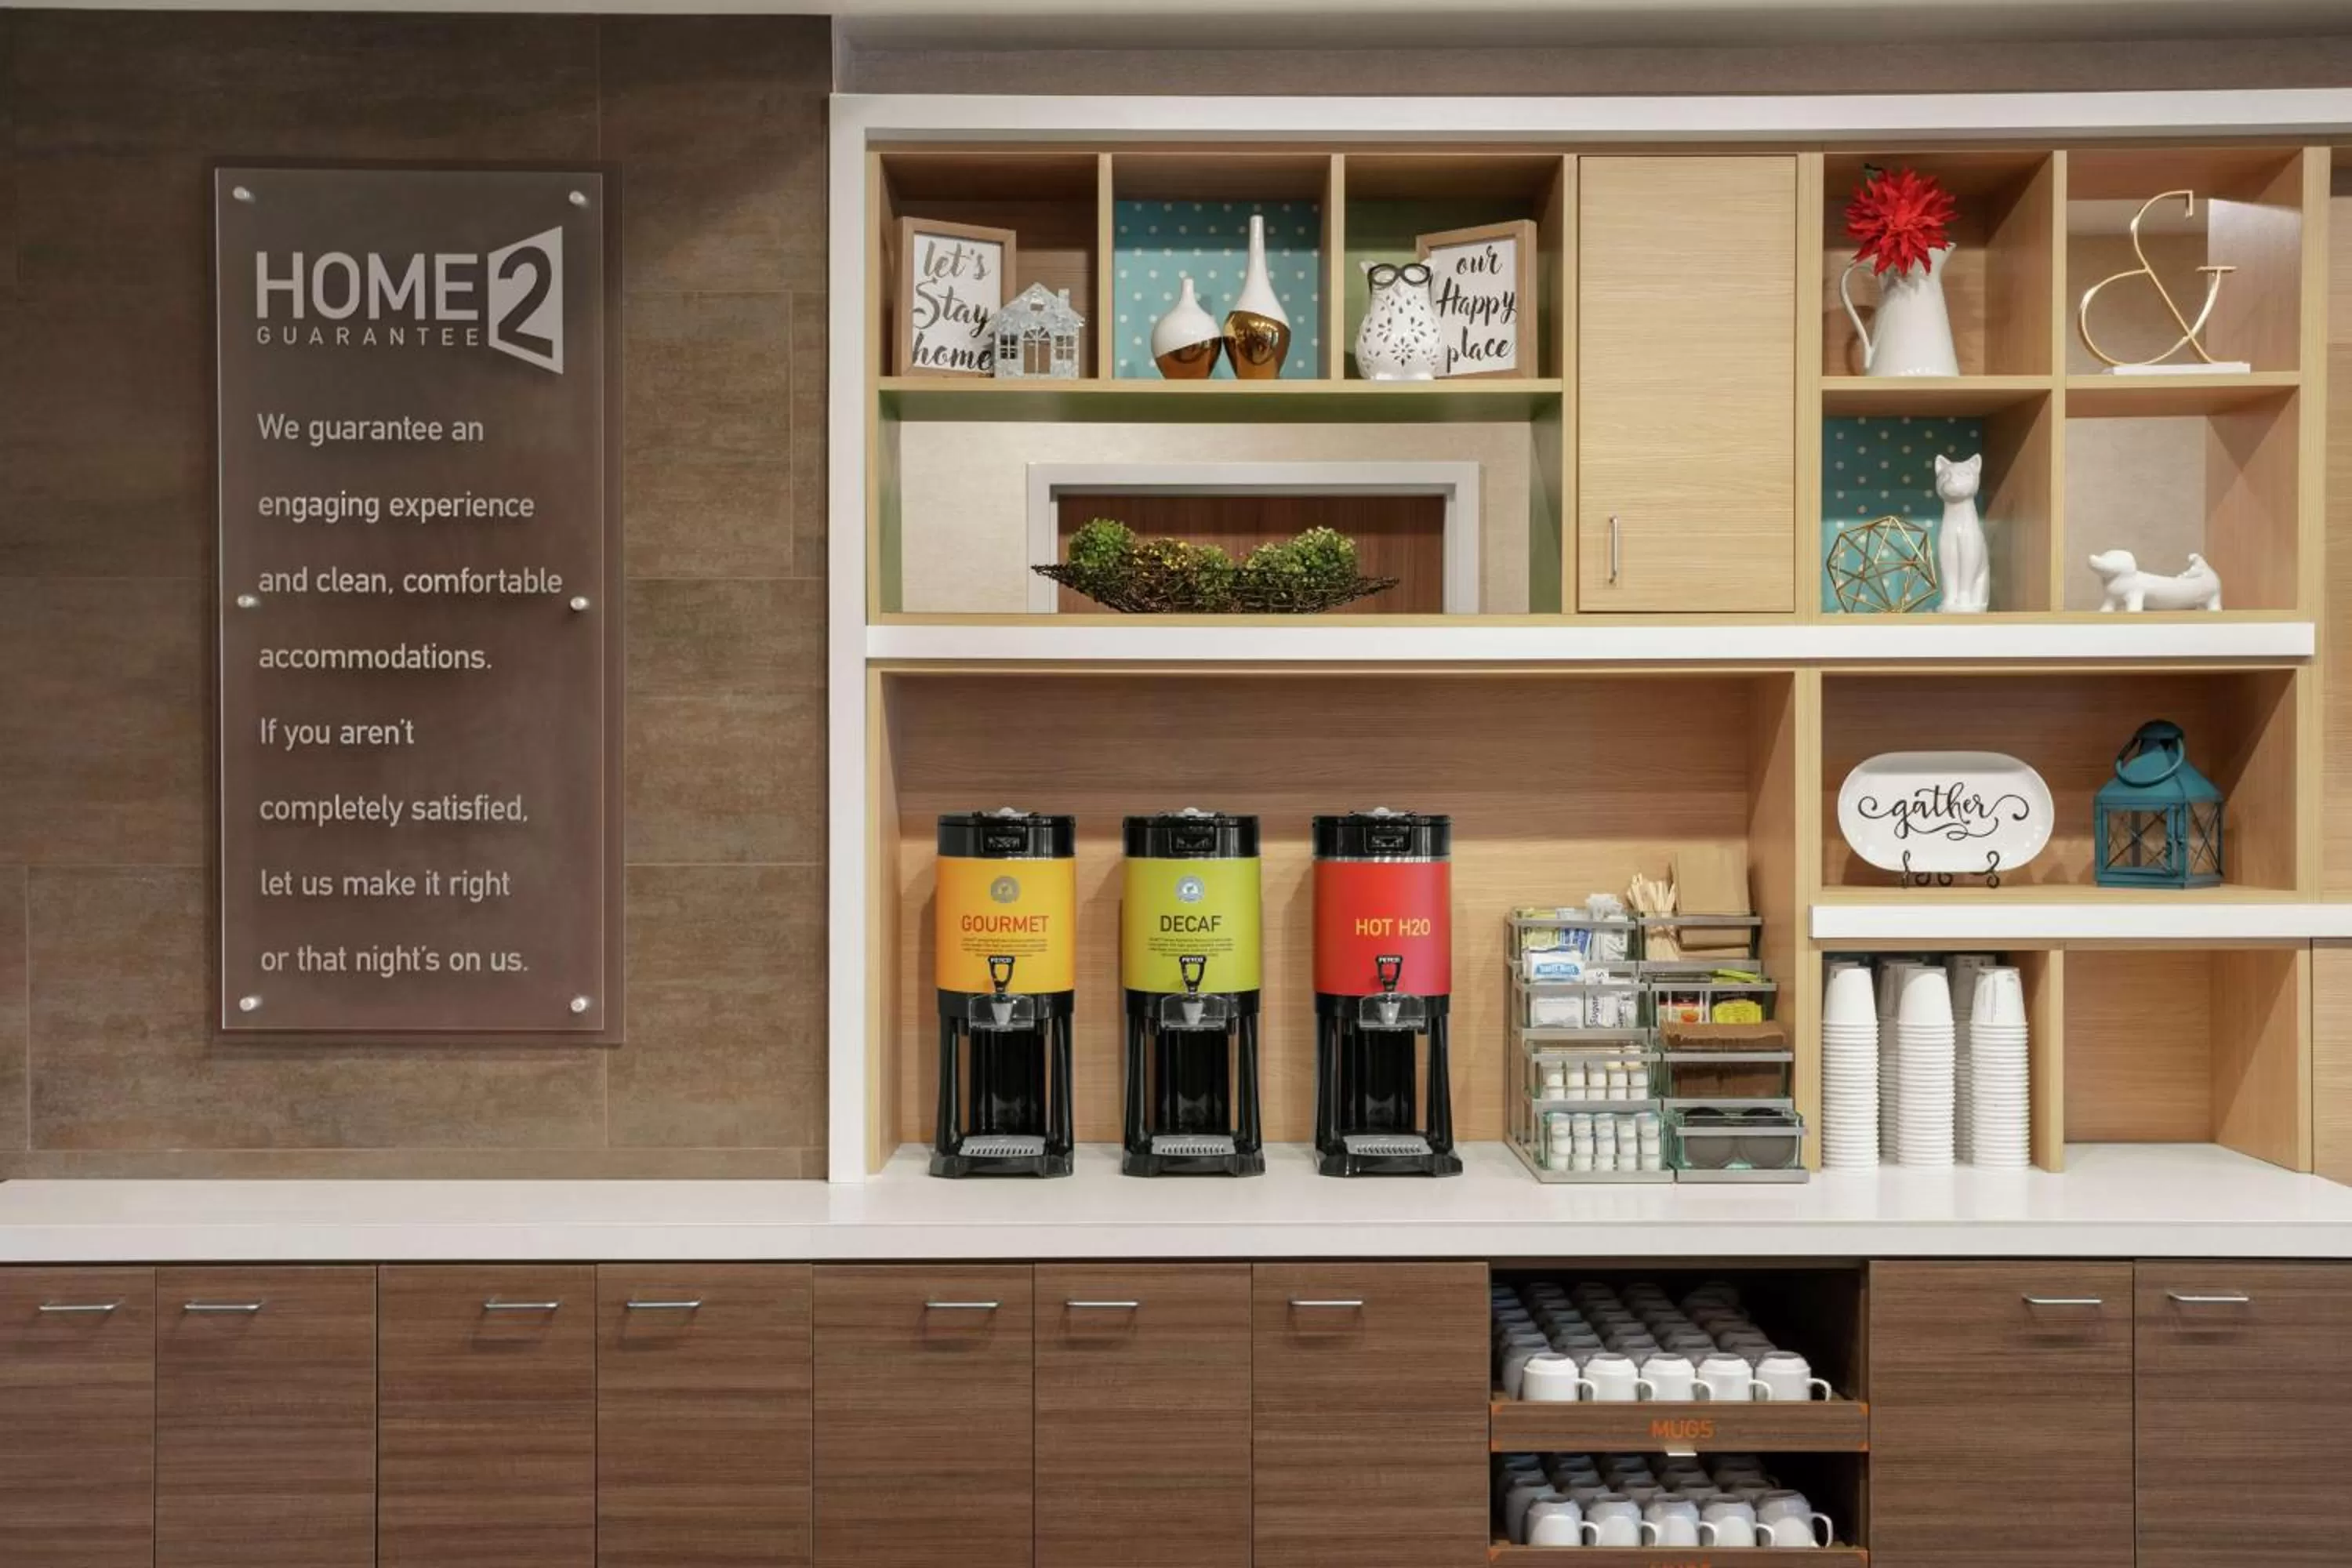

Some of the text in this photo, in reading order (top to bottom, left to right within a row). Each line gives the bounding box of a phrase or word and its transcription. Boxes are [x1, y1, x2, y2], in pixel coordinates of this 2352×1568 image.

[924, 240, 991, 280] let's
[1456, 245, 1503, 274] our
[913, 278, 989, 337] Stay
[1436, 277, 1519, 325] Happy
[256, 325, 479, 347] GUARANTEE
[913, 331, 994, 371] home
[1446, 326, 1513, 373] place
[257, 414, 484, 447] We guarantee an
[259, 490, 535, 524] engaging experience
[258, 566, 563, 595] and clean, comfortable
[259, 643, 492, 670] accommodations.
[260, 717, 415, 752] If you aren't
[260, 793, 528, 828] completely satisfied,
[1858, 782, 2029, 840] gather
[261, 869, 510, 903] let us make it right
[961, 915, 1050, 933] GOURMET
[1160, 915, 1223, 933] DECAF
[1355, 918, 1394, 935] HOT
[261, 945, 528, 978] or that night's on us.
[1650, 1419, 1715, 1439] MUGS
